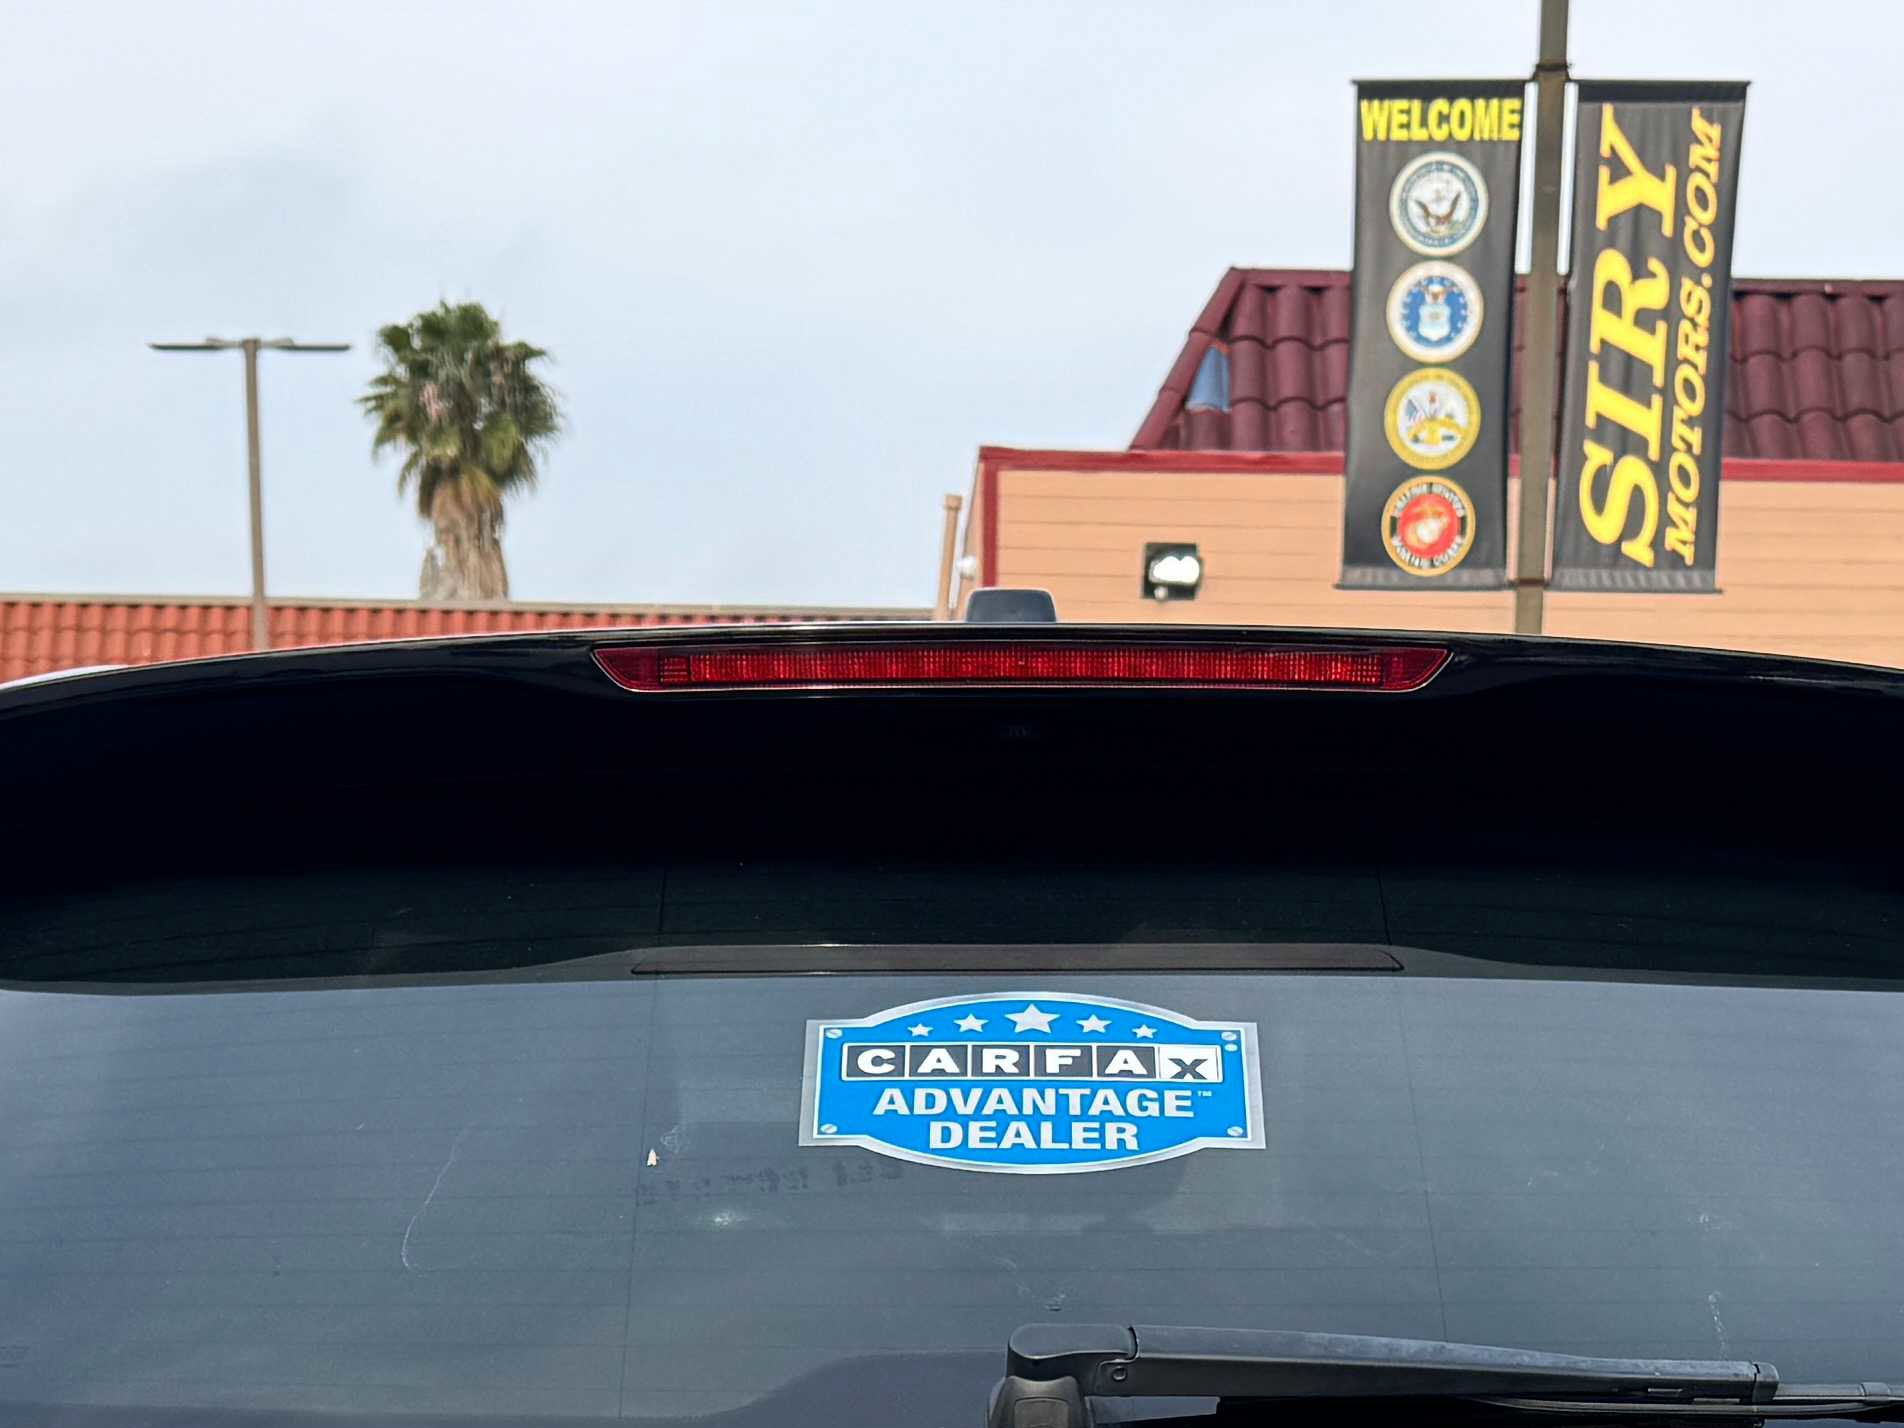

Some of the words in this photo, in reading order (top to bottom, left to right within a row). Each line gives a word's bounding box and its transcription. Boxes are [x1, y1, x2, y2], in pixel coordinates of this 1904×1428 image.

[1360, 97, 1523, 142] WELCOME
[1578, 101, 1678, 568] SIRY
[1664, 107, 1723, 567] MOTORS.COM
[855, 1046, 1209, 1081] CARFAX
[872, 1087, 1195, 1119] ADVANTAGE
[928, 1120, 1141, 1151] DEALER
